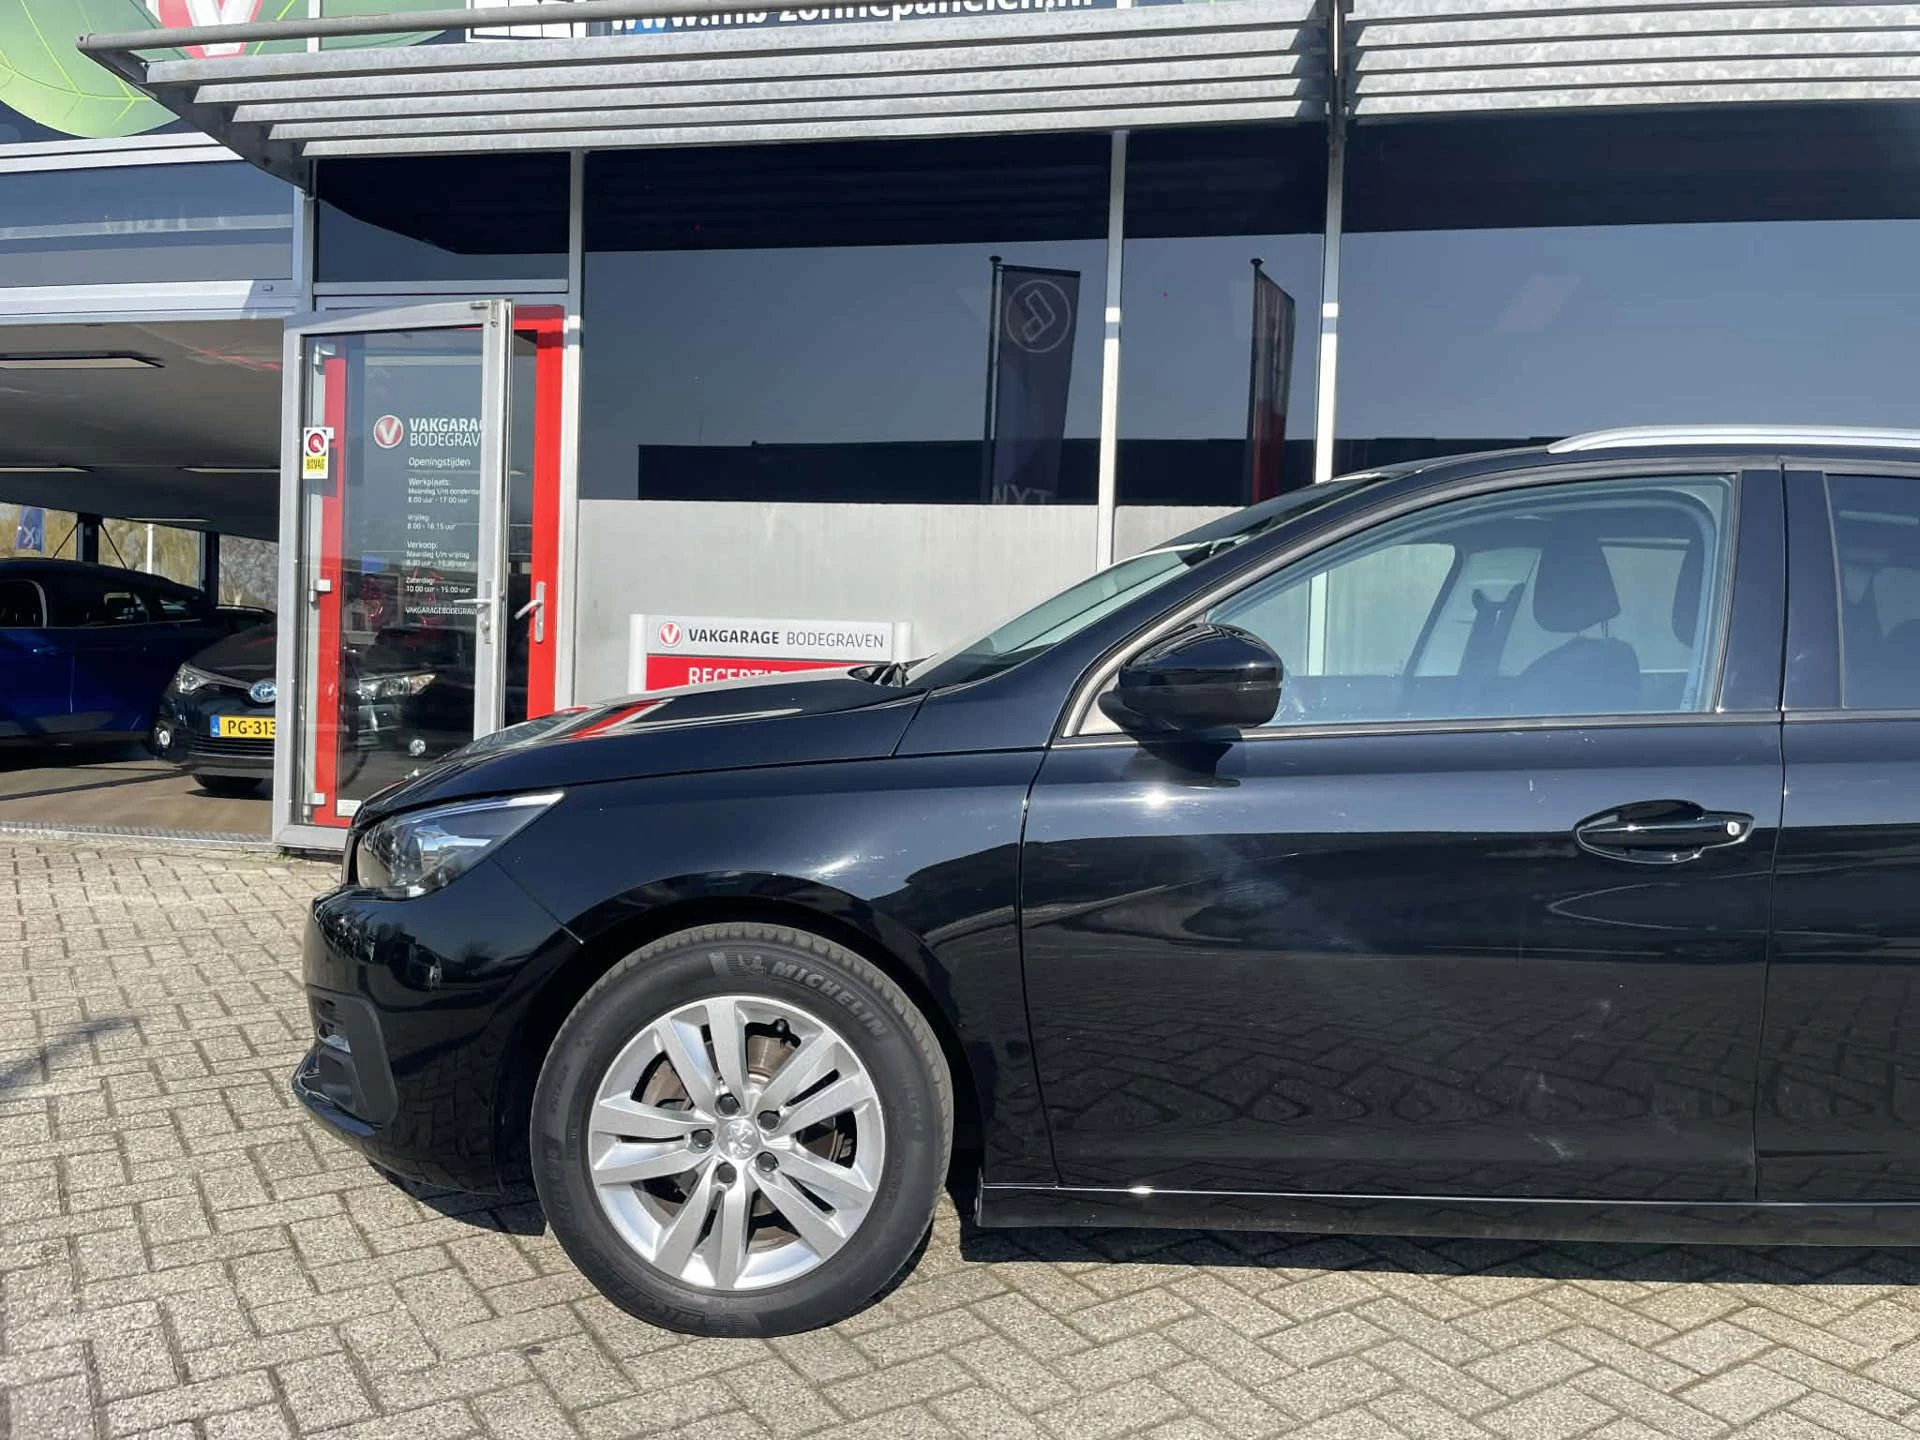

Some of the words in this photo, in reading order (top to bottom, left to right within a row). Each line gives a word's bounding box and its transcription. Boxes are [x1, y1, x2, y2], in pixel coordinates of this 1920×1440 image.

[408, 456, 471, 469] Openingstijden
[689, 628, 780, 645] VAKGARAGE
[787, 631, 884, 648] BODEGRAVEN
[771, 960, 888, 1036] MICHELIN
